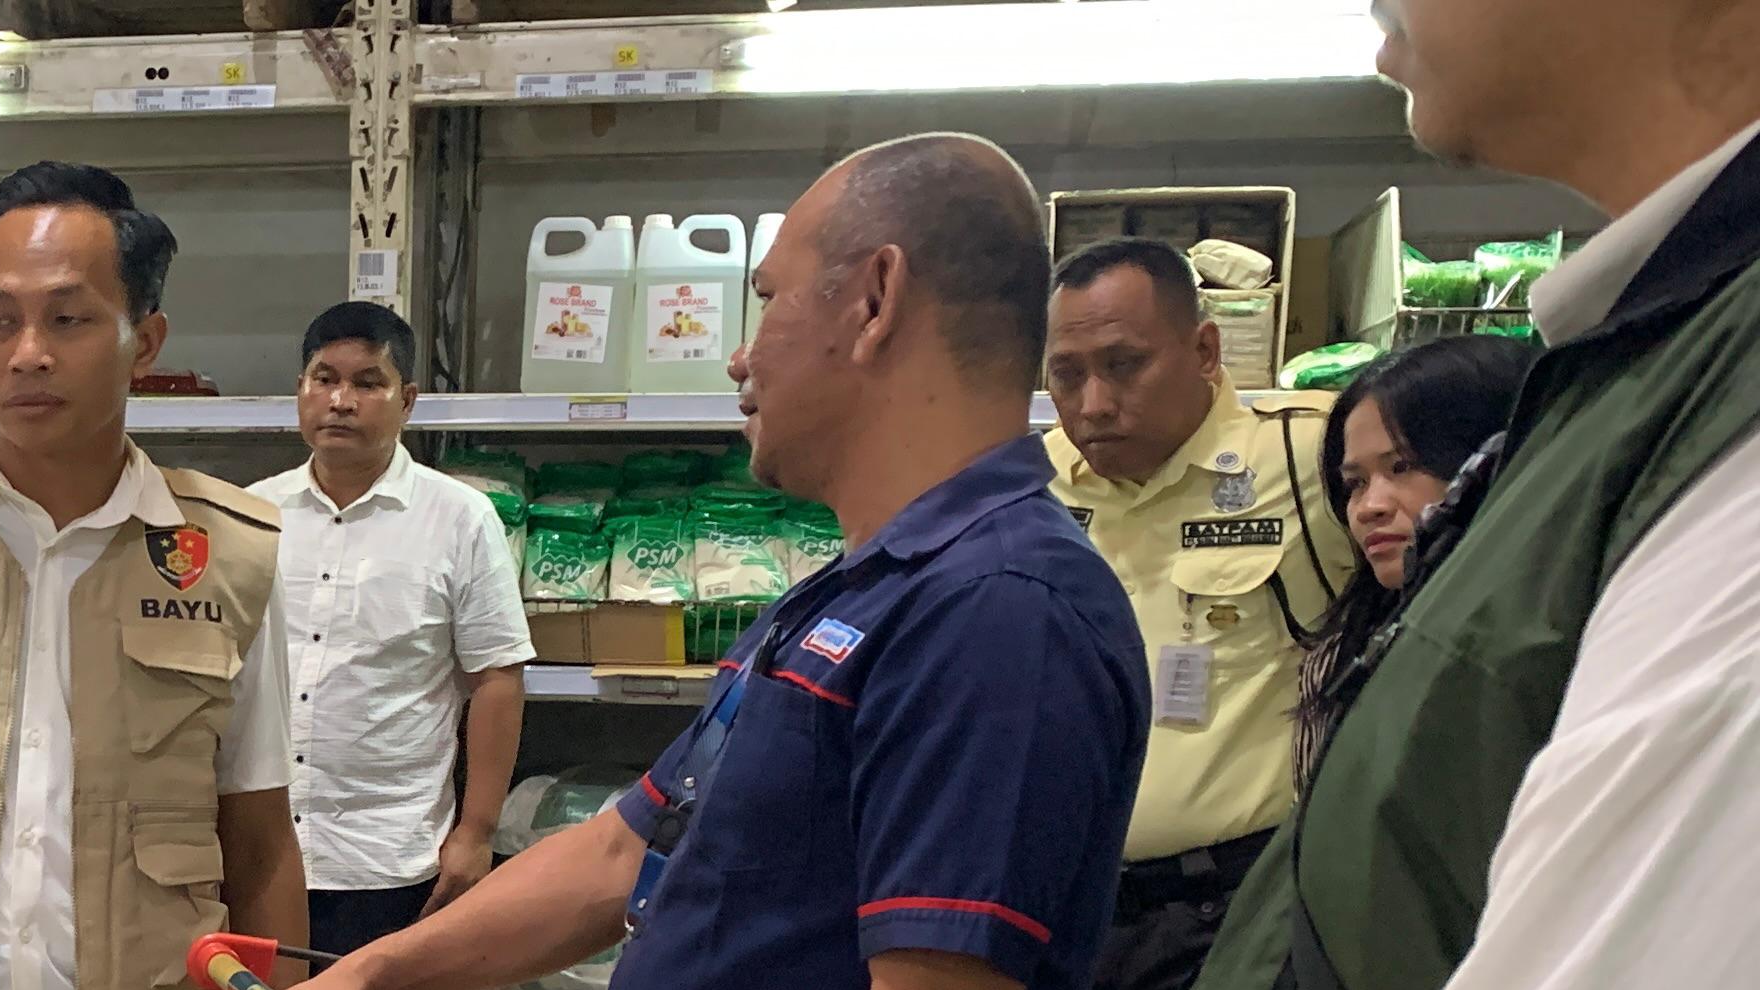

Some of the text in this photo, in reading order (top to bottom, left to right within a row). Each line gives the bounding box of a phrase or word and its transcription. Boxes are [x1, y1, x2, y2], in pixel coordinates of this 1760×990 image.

[618, 50, 635, 63] SK
[225, 67, 240, 79] SK
[571, 299, 597, 307] BRAND
[682, 297, 708, 306] BRAND
[635, 546, 677, 566] PSM
[539, 561, 582, 582] PSM
[141, 598, 222, 623] BAYU
